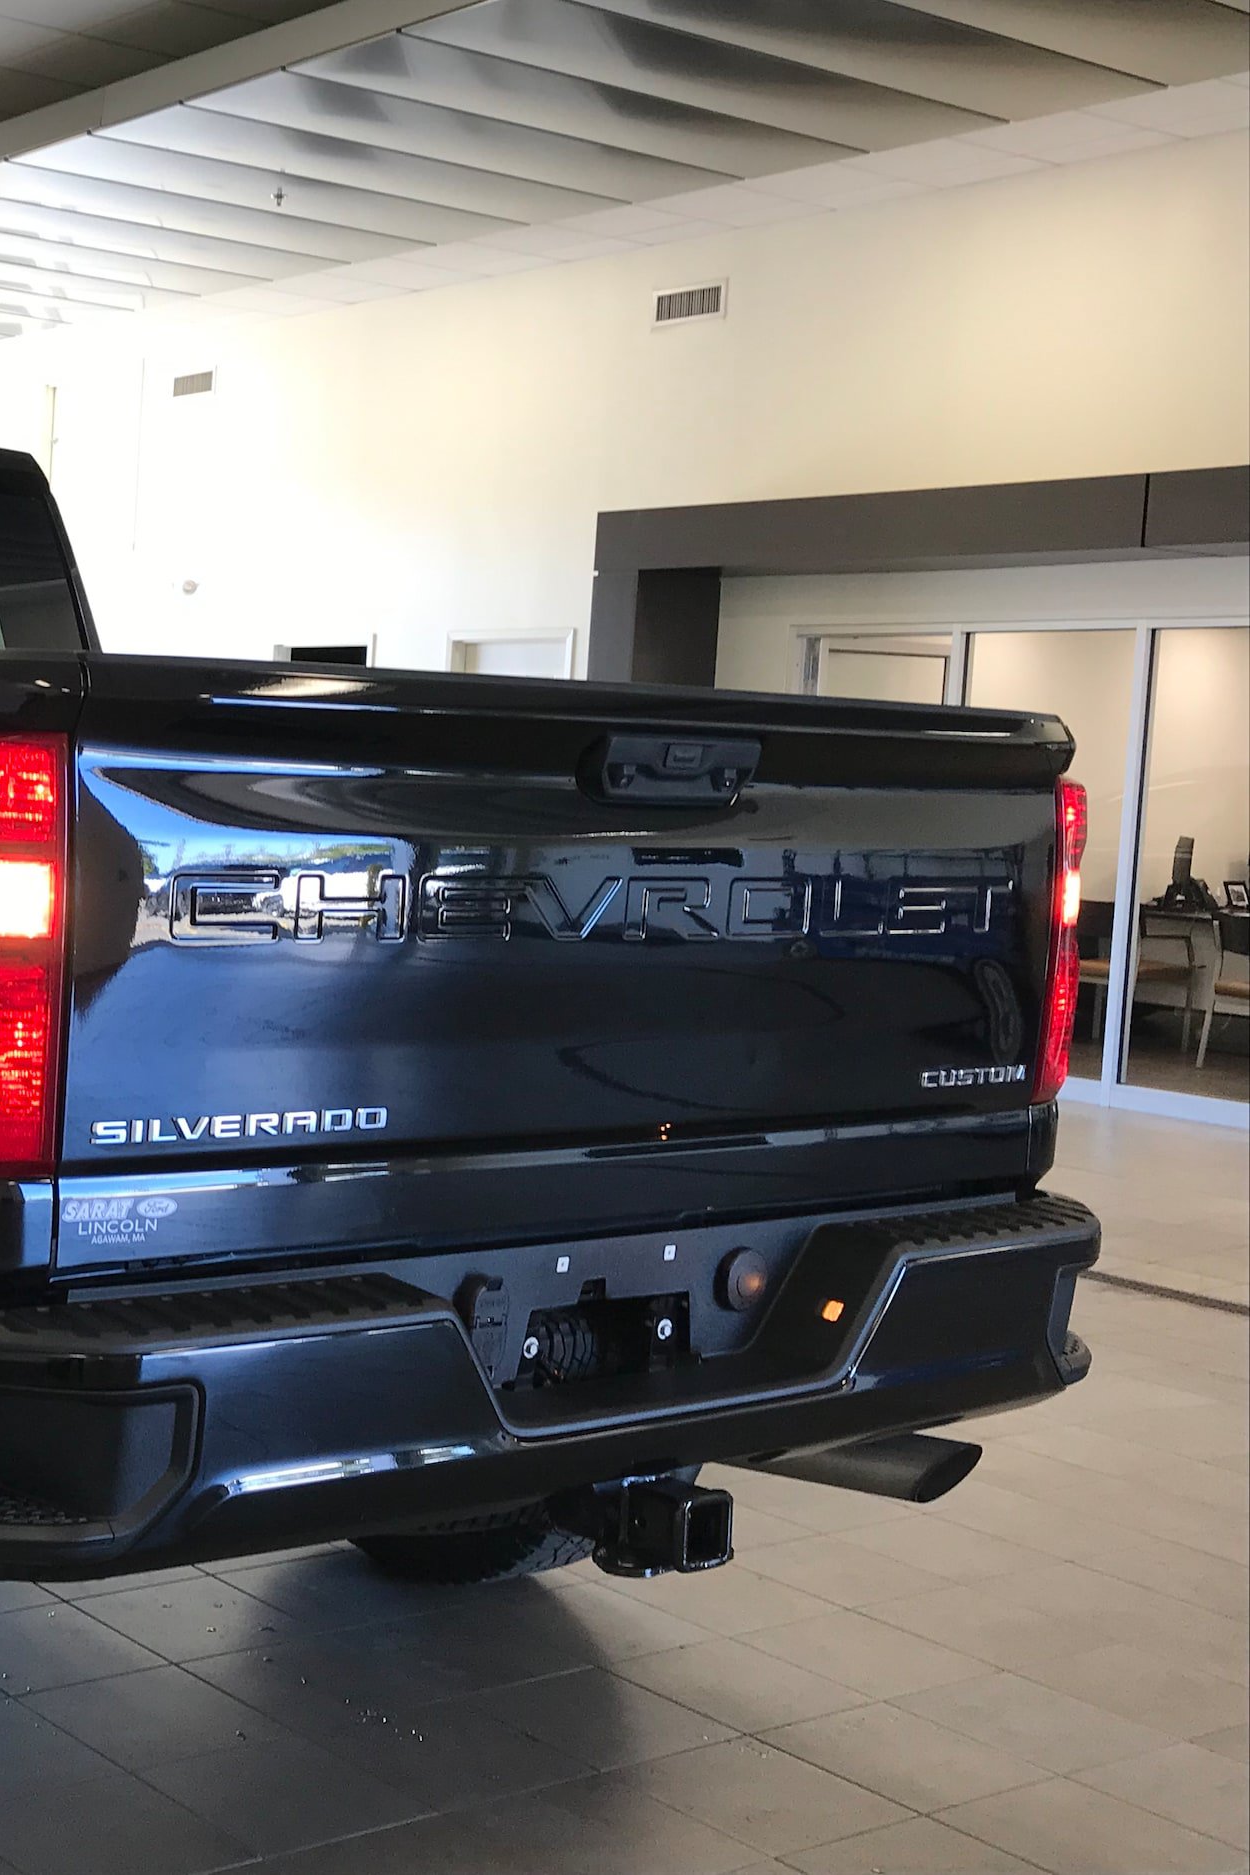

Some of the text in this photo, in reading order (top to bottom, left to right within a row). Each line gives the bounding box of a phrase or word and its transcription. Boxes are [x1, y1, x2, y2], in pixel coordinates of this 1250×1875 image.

[169, 869, 1015, 945] CHEVROLET
[920, 1064, 1027, 1088] CUSTOM
[91, 1107, 388, 1145] SILVERADO
[62, 1199, 134, 1222] SARAT
[78, 1218, 157, 1236] LINCOLN
[132, 1232, 146, 1243] MA
